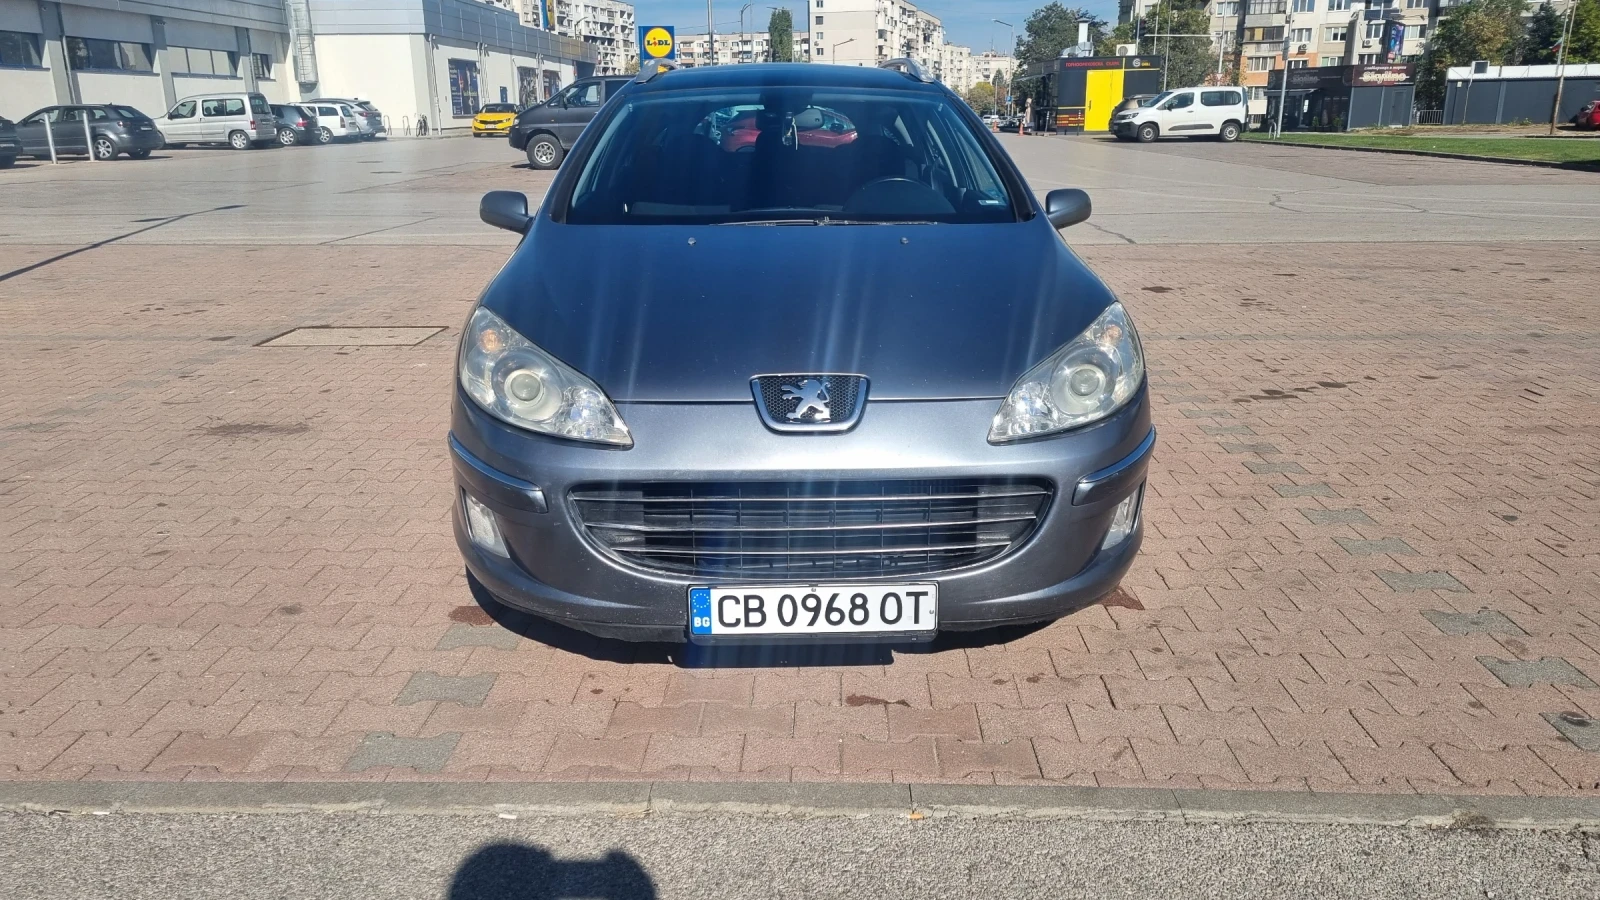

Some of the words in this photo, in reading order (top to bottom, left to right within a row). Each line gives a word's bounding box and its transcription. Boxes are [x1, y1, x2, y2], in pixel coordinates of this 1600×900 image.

[693, 616, 710, 627] BG
[717, 594, 767, 628] CB
[777, 593, 870, 627] 0968
[879, 591, 929, 625] OT
